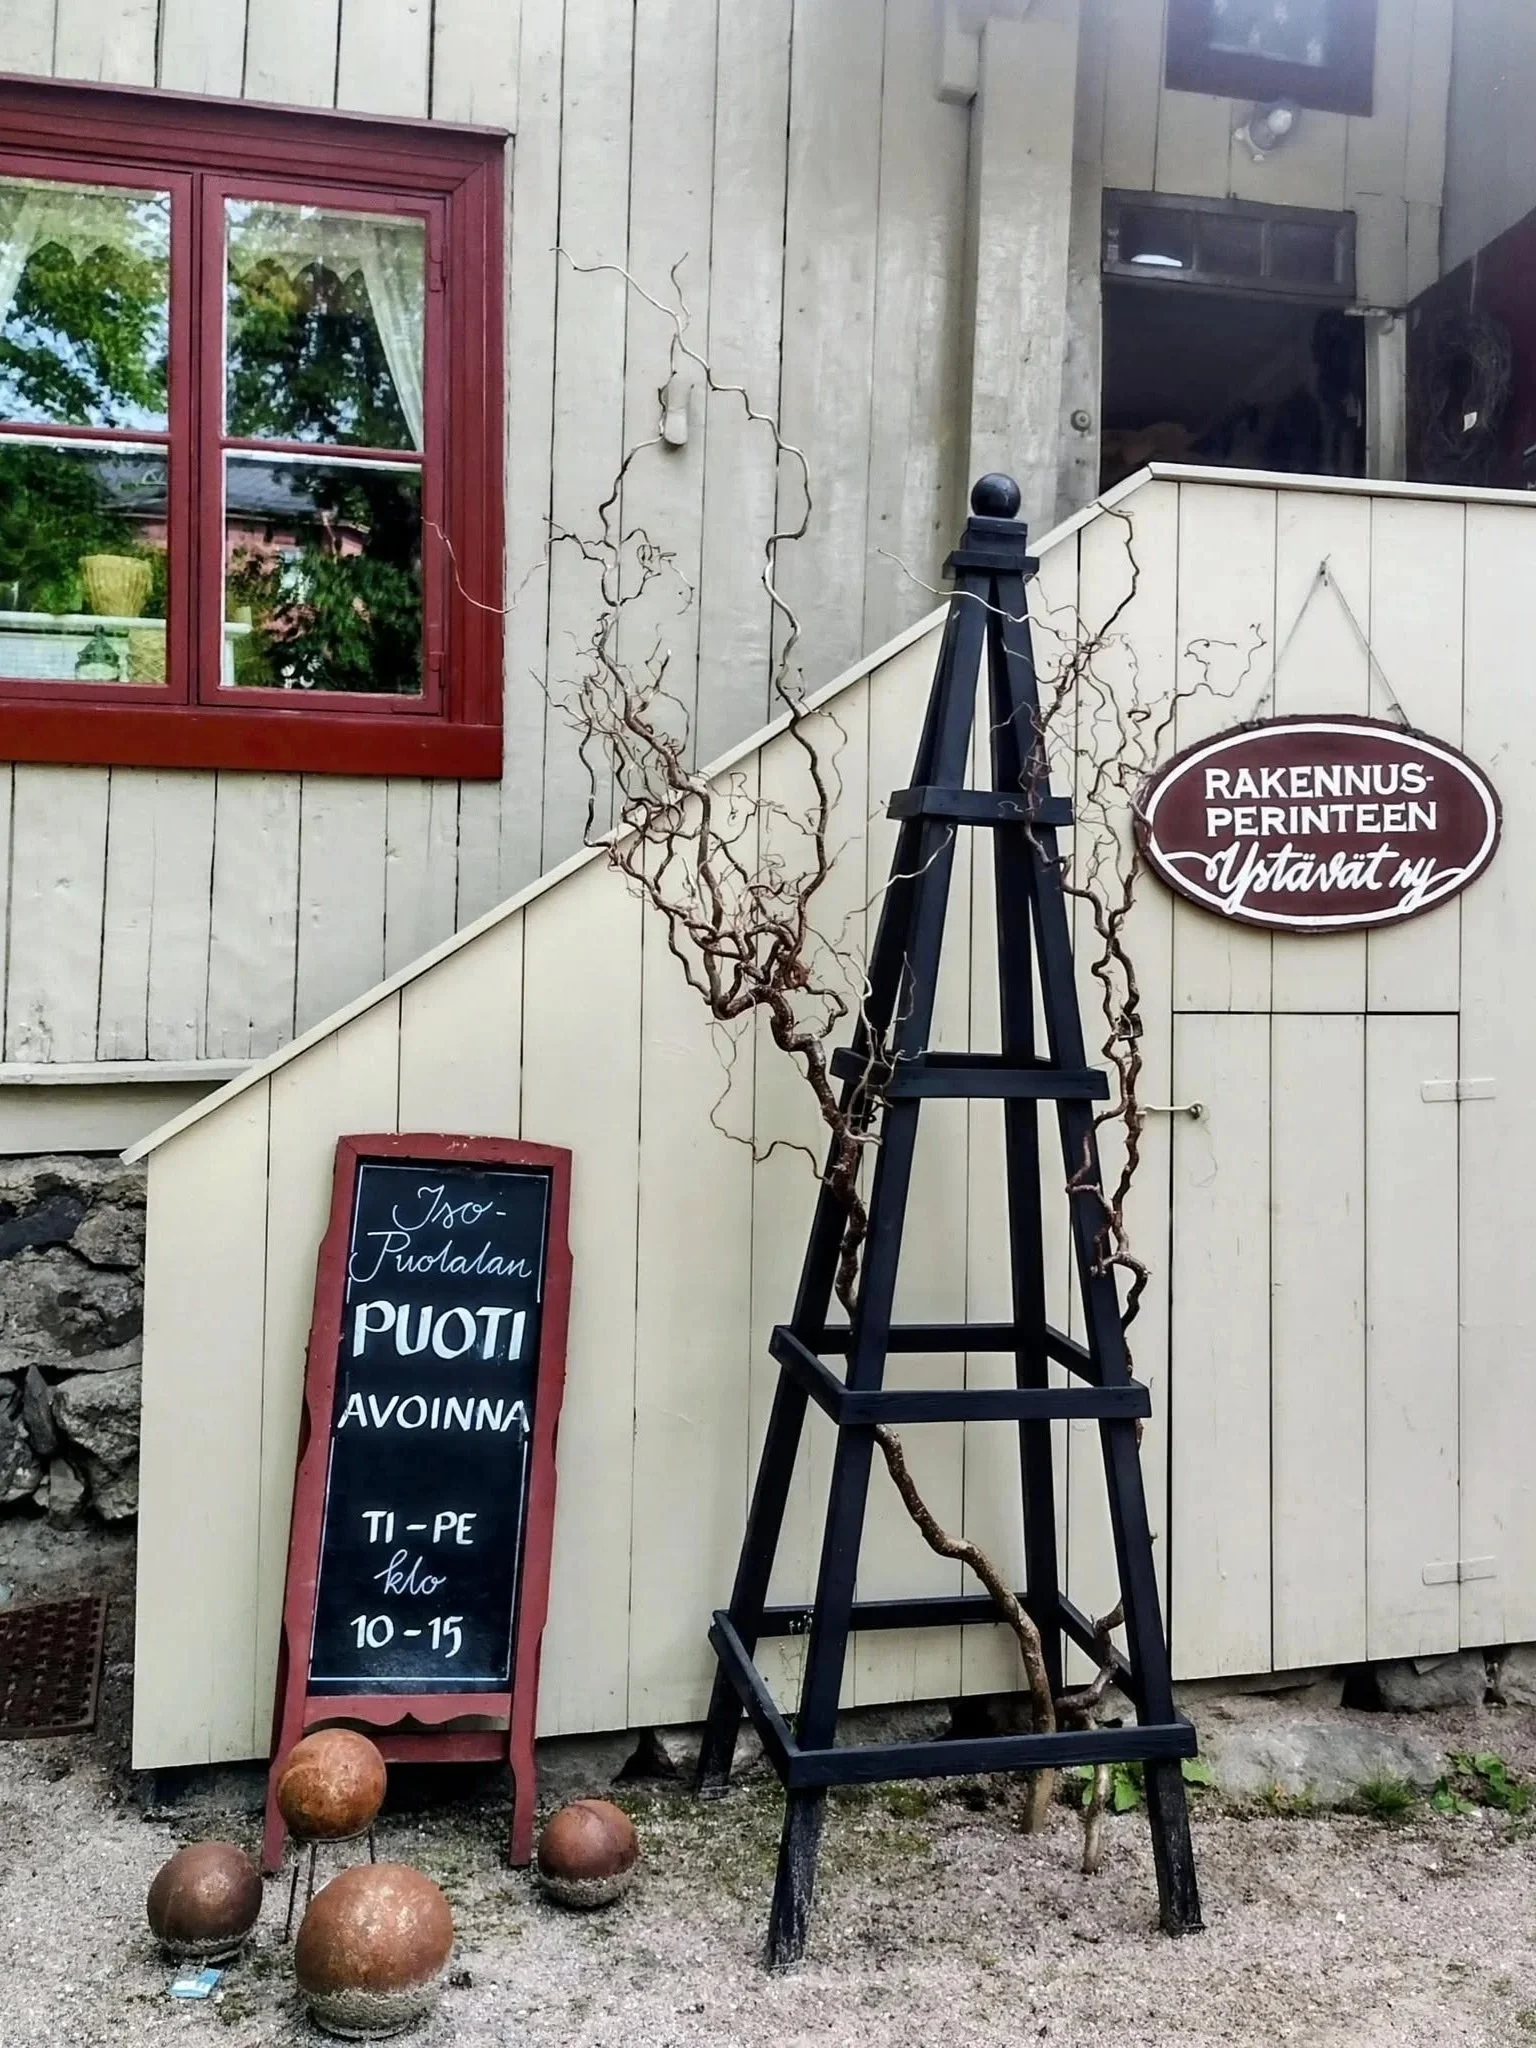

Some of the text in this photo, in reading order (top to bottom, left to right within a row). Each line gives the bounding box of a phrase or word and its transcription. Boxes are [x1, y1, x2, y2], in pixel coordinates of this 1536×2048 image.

[1205, 763, 1435, 800] RAKENNUS-
[1206, 802, 1437, 837] PERINTEEN
[1205, 841, 1401, 914] Ystävät
[392, 1184, 507, 1231] Iso-
[348, 1231, 533, 1284] Puolalan
[352, 1299, 527, 1360] PUOTI
[337, 1392, 531, 1433] AVOINNA
[374, 1549, 447, 1596] klo
